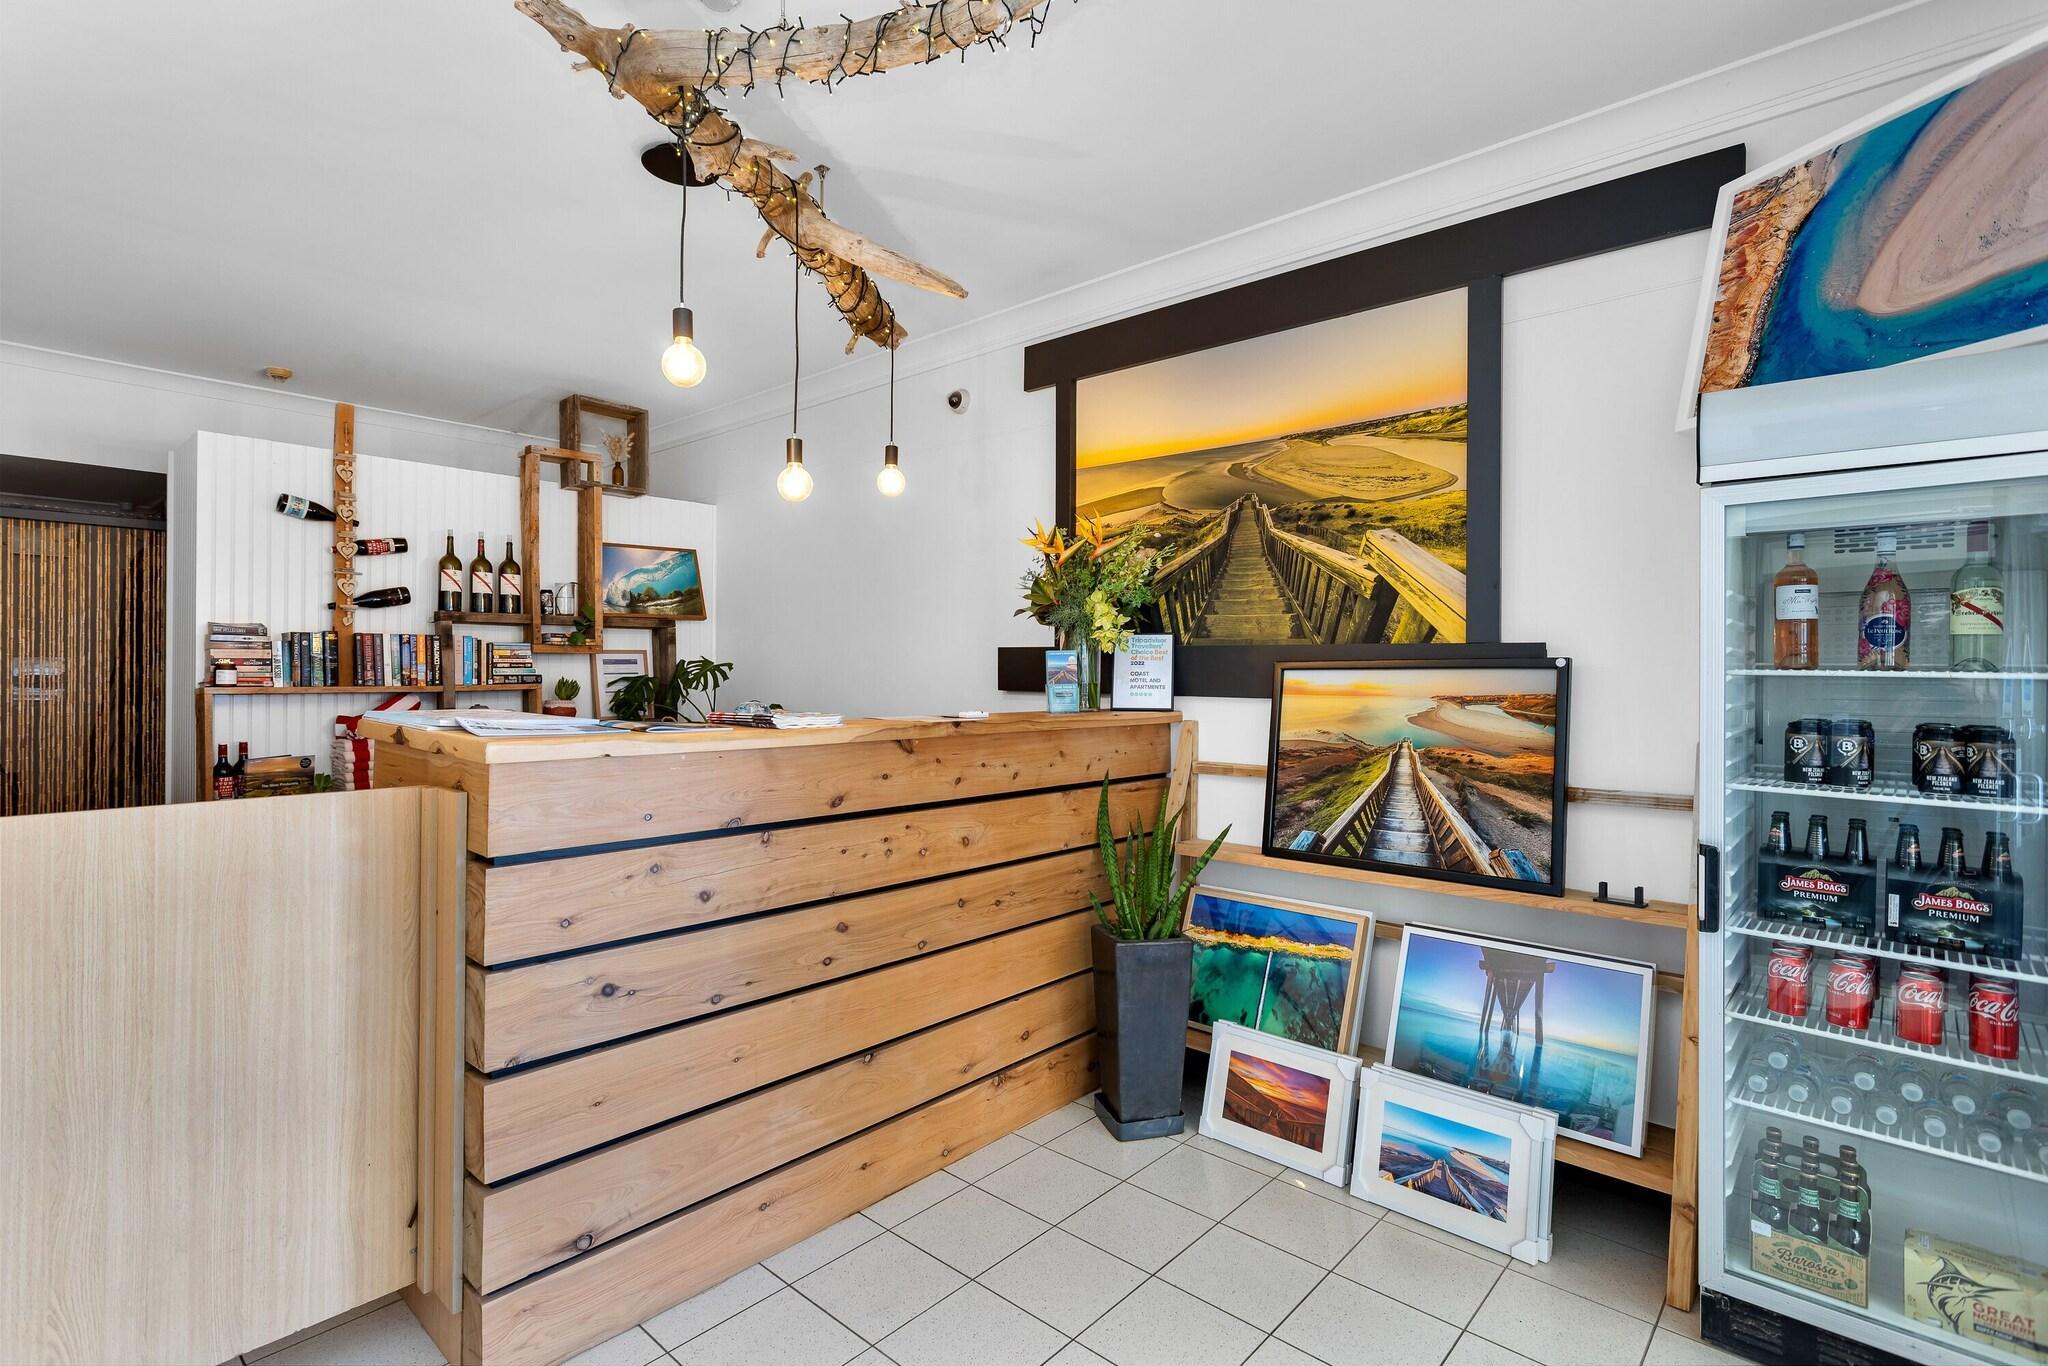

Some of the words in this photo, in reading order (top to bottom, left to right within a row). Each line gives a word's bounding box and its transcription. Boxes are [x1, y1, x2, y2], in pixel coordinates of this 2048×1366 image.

[1781, 877, 1815, 889] JAMES
[1793, 890, 1838, 903] PREMIUM
[1913, 895, 1953, 908] JAMES
[1928, 909, 1980, 923] PREMIUM
[1777, 1247, 1840, 1277] Barossa
[1782, 1267, 1808, 1280] APPLE
[1809, 1276, 1833, 1287] CIDER
[1973, 1302, 2035, 1328] GREAT
[1973, 1311, 2035, 1337] NORTHERN
